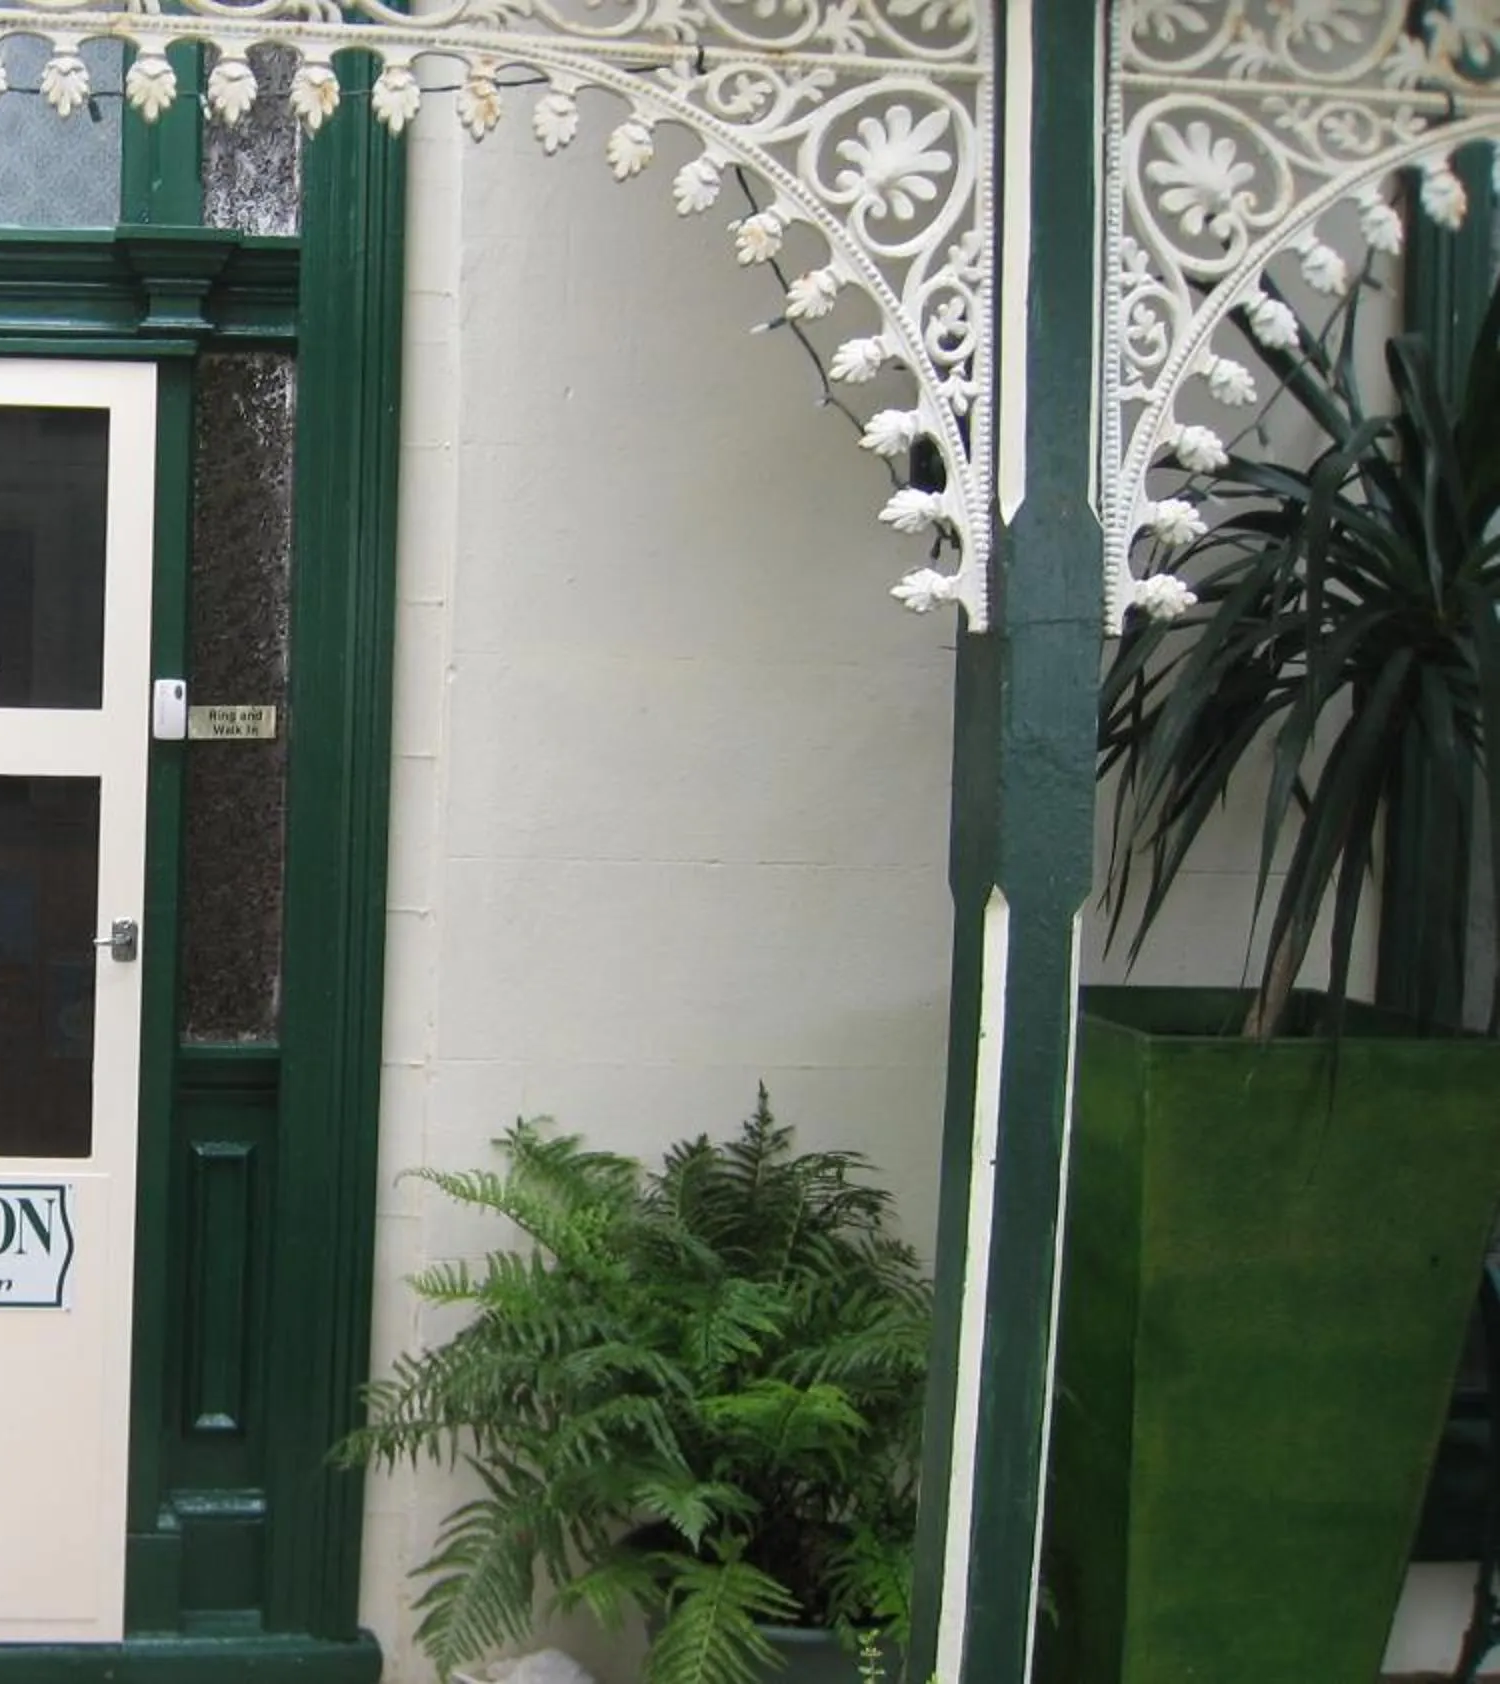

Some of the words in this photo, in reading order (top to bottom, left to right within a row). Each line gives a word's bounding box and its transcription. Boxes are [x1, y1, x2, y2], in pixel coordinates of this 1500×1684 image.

[209, 711, 237, 722] Ring
[240, 710, 263, 721] and
[213, 725, 242, 736] Walk
[246, 725, 259, 736] In
